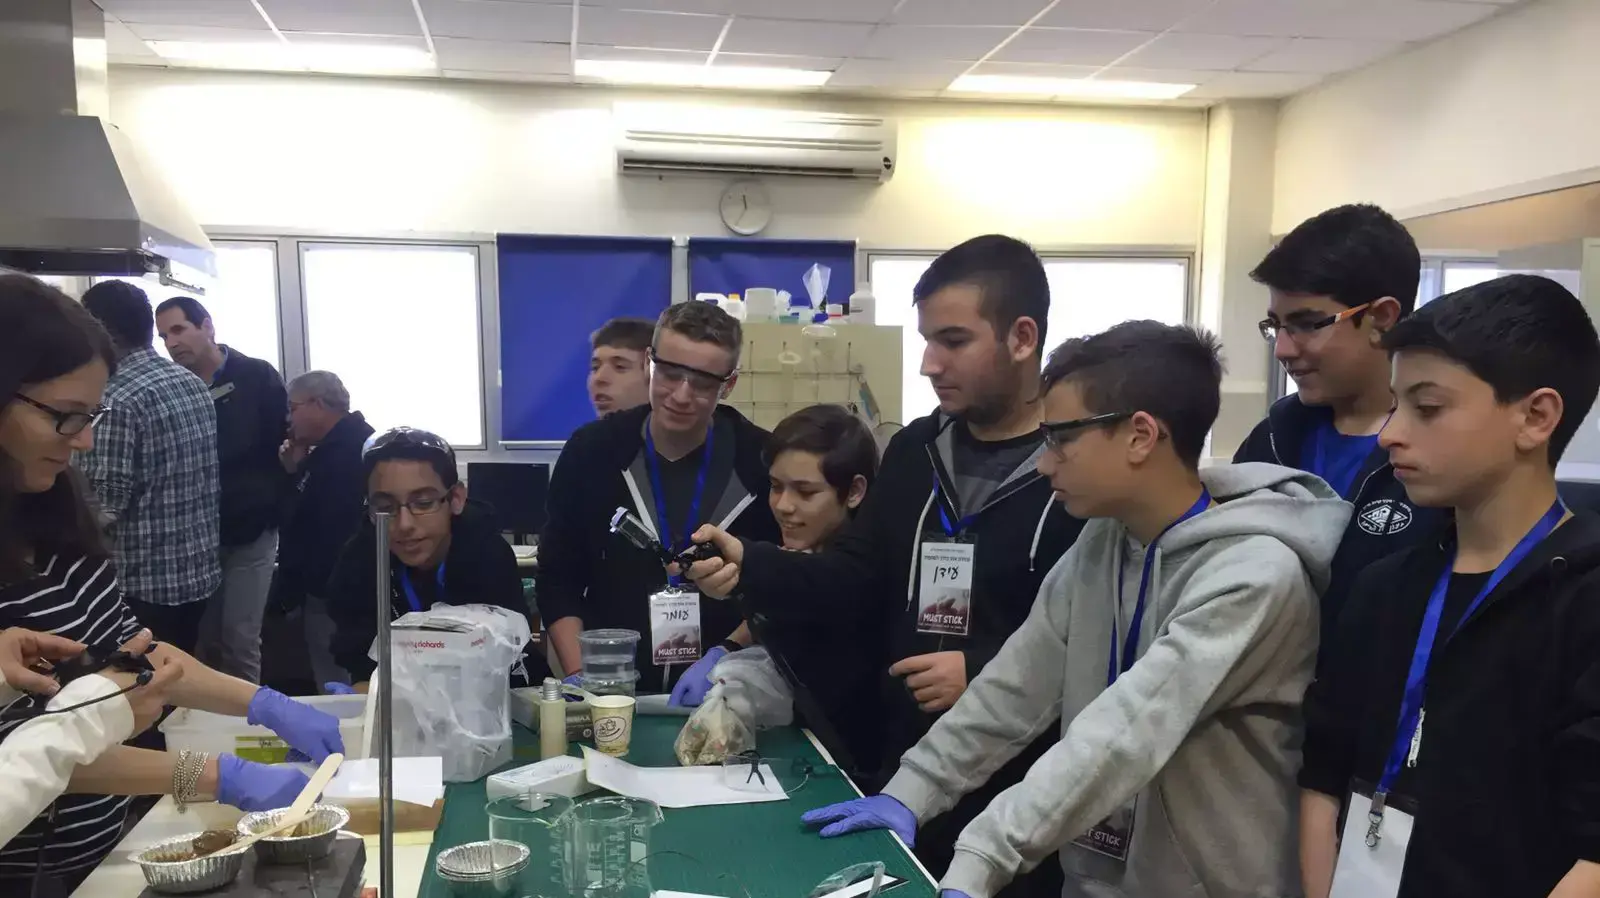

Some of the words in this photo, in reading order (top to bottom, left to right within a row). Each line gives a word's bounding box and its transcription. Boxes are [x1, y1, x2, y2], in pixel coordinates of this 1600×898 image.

[933, 566, 959, 584] עידן
[661, 609, 689, 621] עומר
[923, 613, 943, 623] MUST
[943, 615, 963, 625] STICK
[658, 648, 677, 657] MUST
[678, 647, 697, 655] STICK
[1094, 831, 1121, 847] STICK
